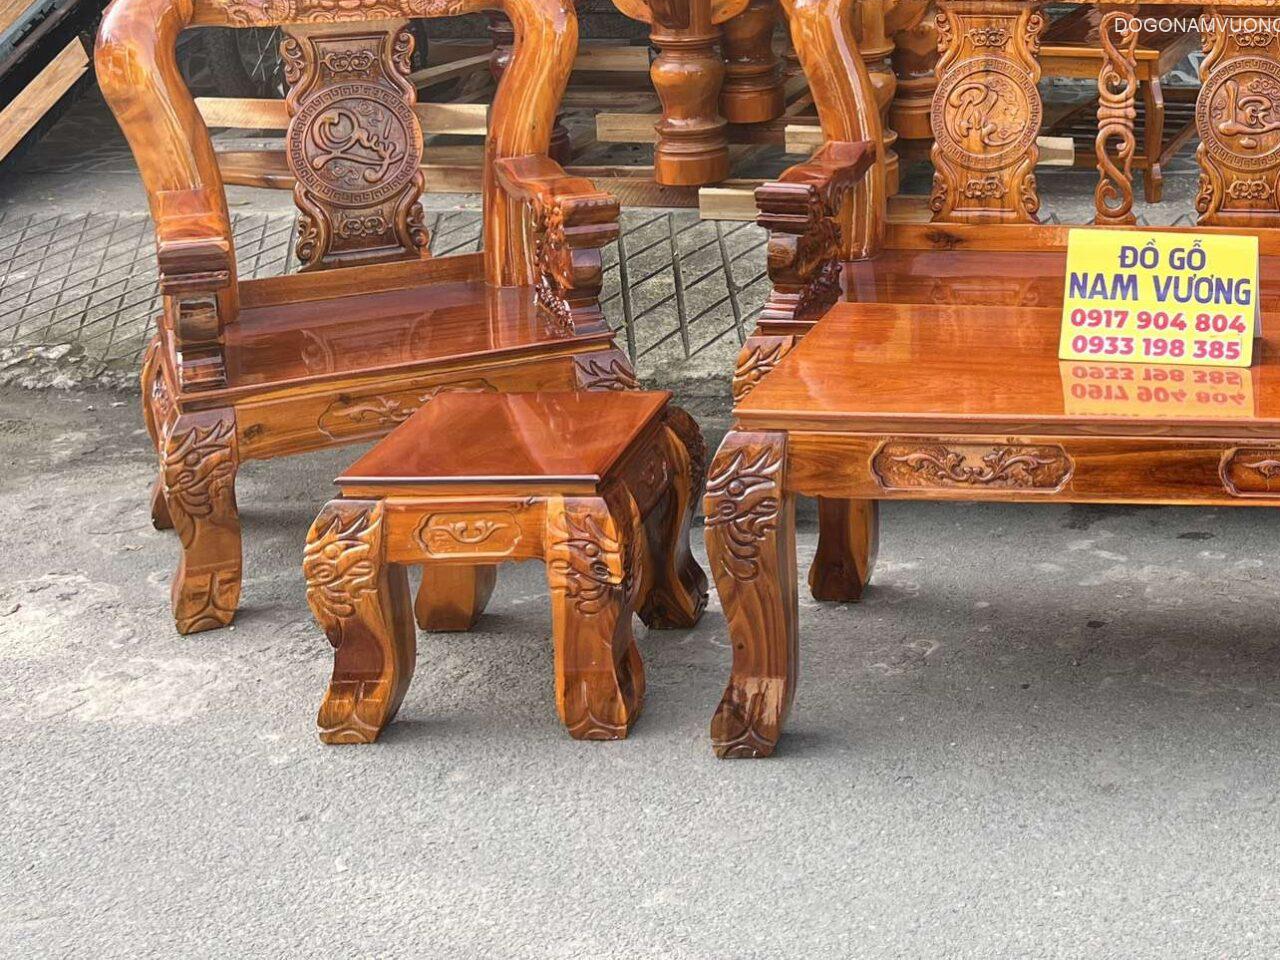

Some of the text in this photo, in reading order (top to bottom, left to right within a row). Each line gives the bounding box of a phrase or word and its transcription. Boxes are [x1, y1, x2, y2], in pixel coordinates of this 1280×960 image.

[1118, 239, 1206, 270] ĐỒ GỖ
[1069, 273, 1251, 306] NAM VƯƠNG
[1070, 308, 1246, 333] 0917 904 804
[1072, 335, 1240, 359] 0933 198 385
